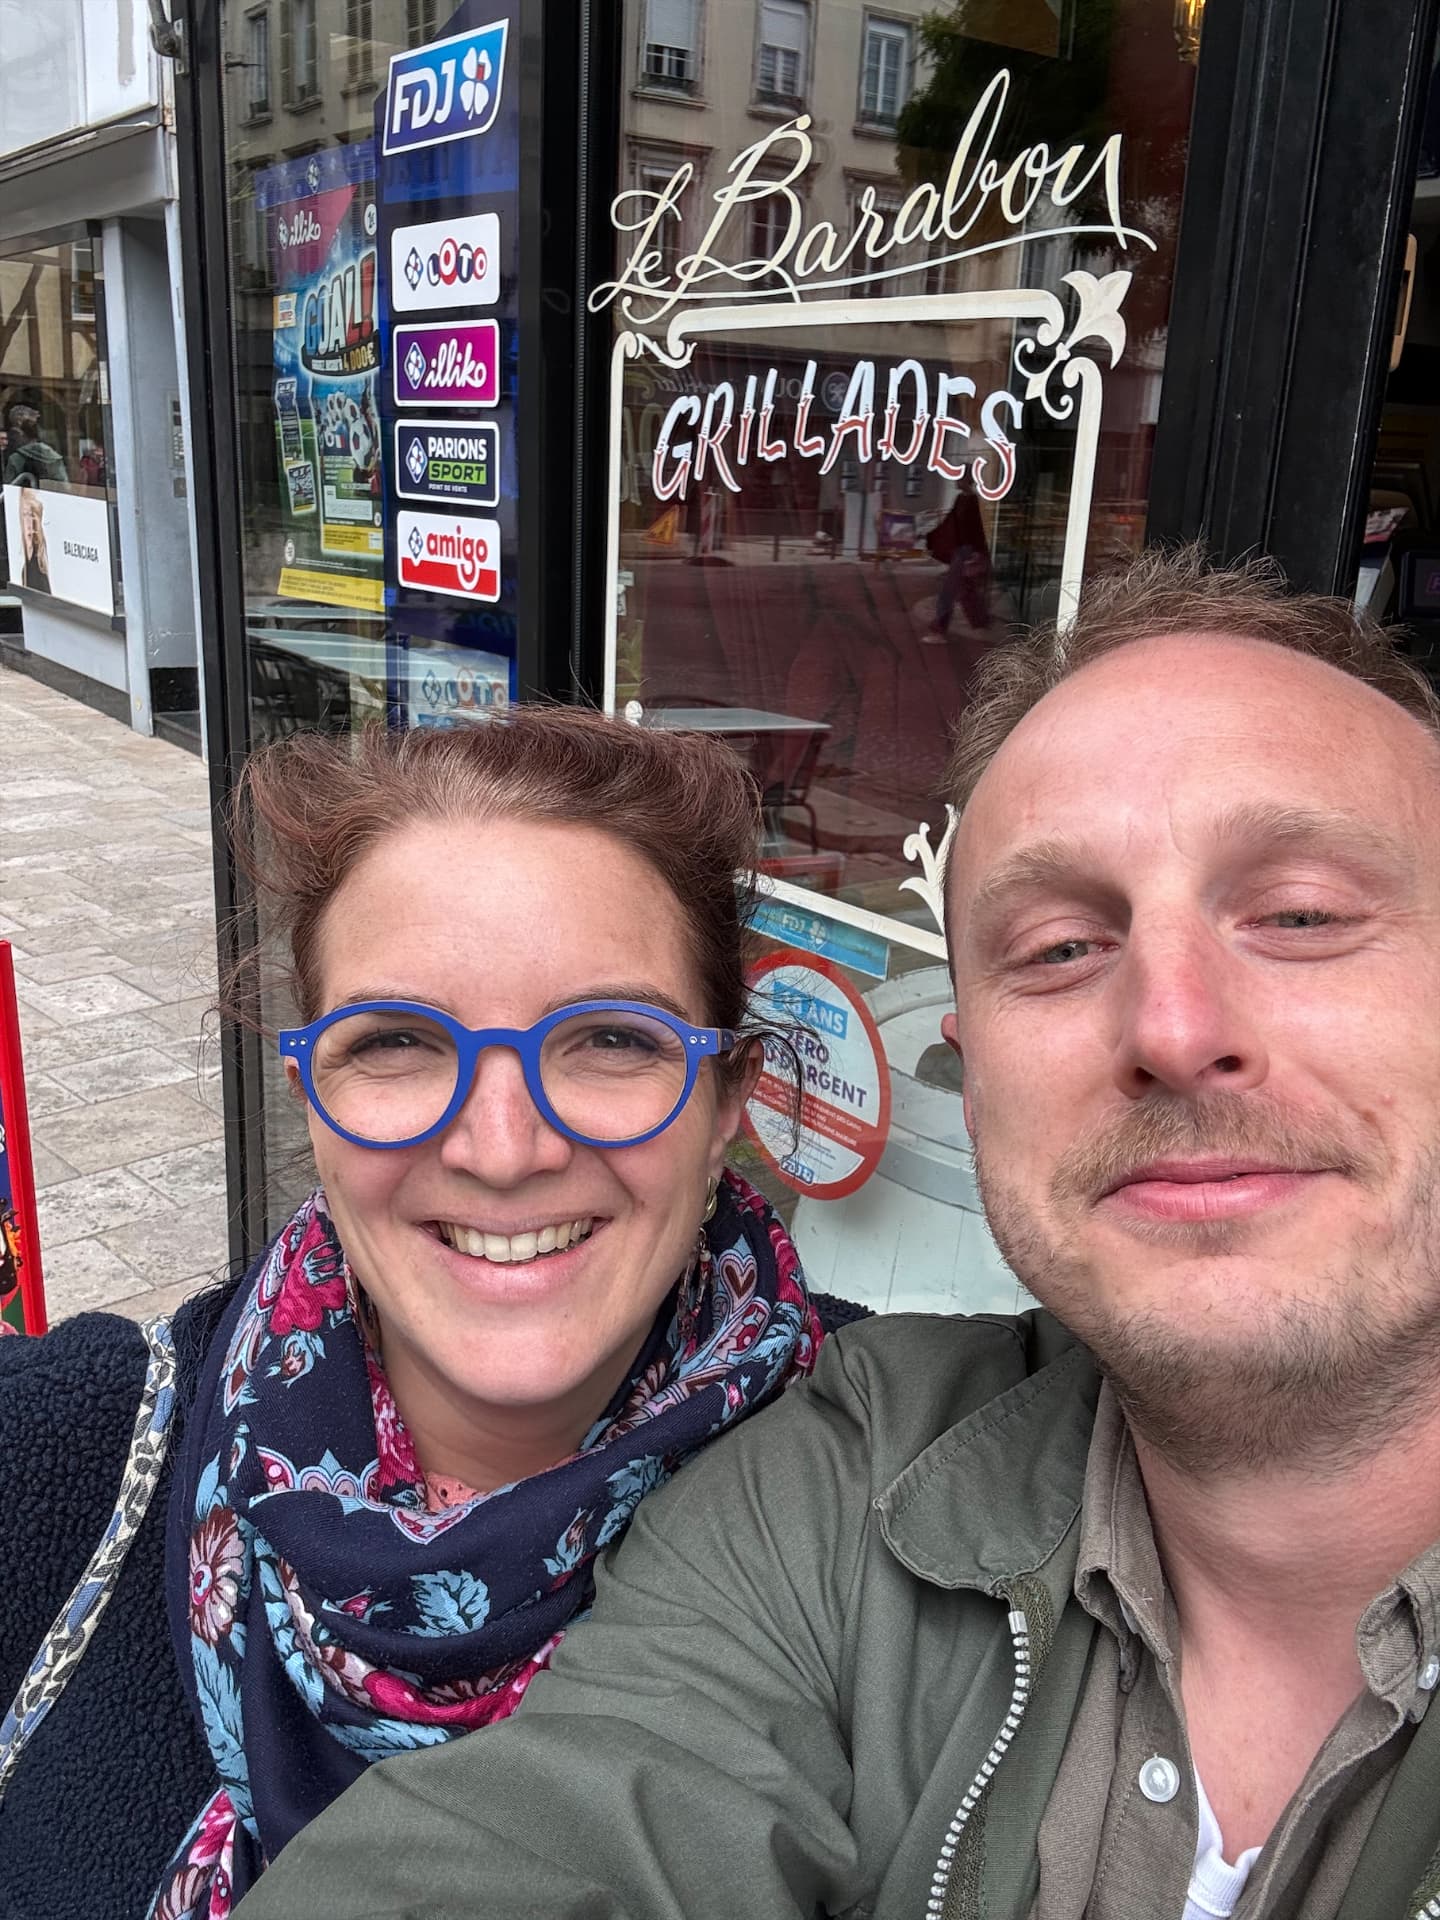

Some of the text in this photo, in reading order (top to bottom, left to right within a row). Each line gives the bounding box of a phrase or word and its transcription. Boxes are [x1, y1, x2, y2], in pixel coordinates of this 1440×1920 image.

[391, 59, 456, 134] FDJ
[588, 68, 1130, 324] Le Barabou
[289, 204, 321, 247] illiko
[427, 238, 488, 286] LOTO
[304, 251, 375, 356] GOAL!
[424, 338, 487, 387] illiko
[428, 437, 487, 461] PARIONS
[652, 359, 1024, 501] GRILLADES
[431, 463, 484, 481] SPORT
[64, 541, 99, 563] BALENCIAGA
[427, 525, 488, 583] amigo
[782, 913, 806, 933] FDJ
